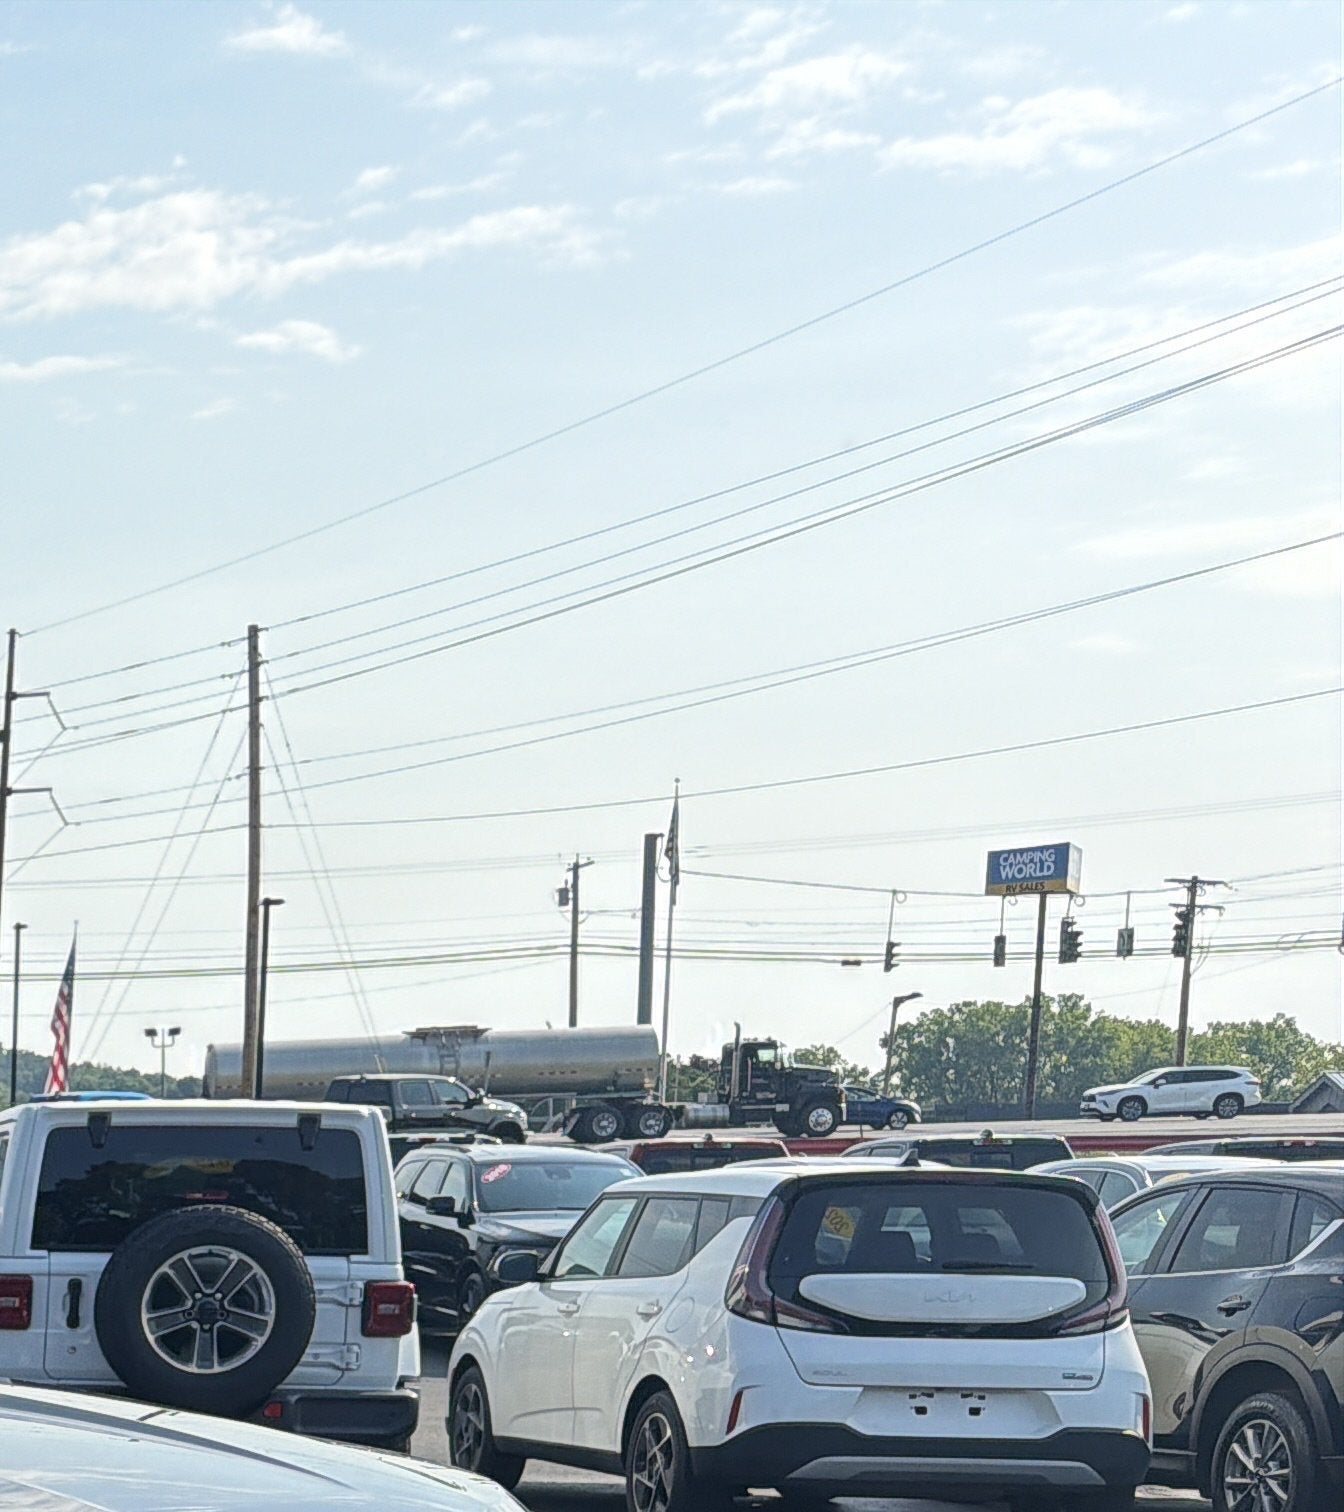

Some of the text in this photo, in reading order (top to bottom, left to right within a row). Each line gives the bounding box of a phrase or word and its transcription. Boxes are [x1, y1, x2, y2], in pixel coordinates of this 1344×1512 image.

[999, 849, 1055, 866] CAMPING
[999, 861, 1055, 881] WORLD
[1005, 881, 1045, 893] RV SALES
